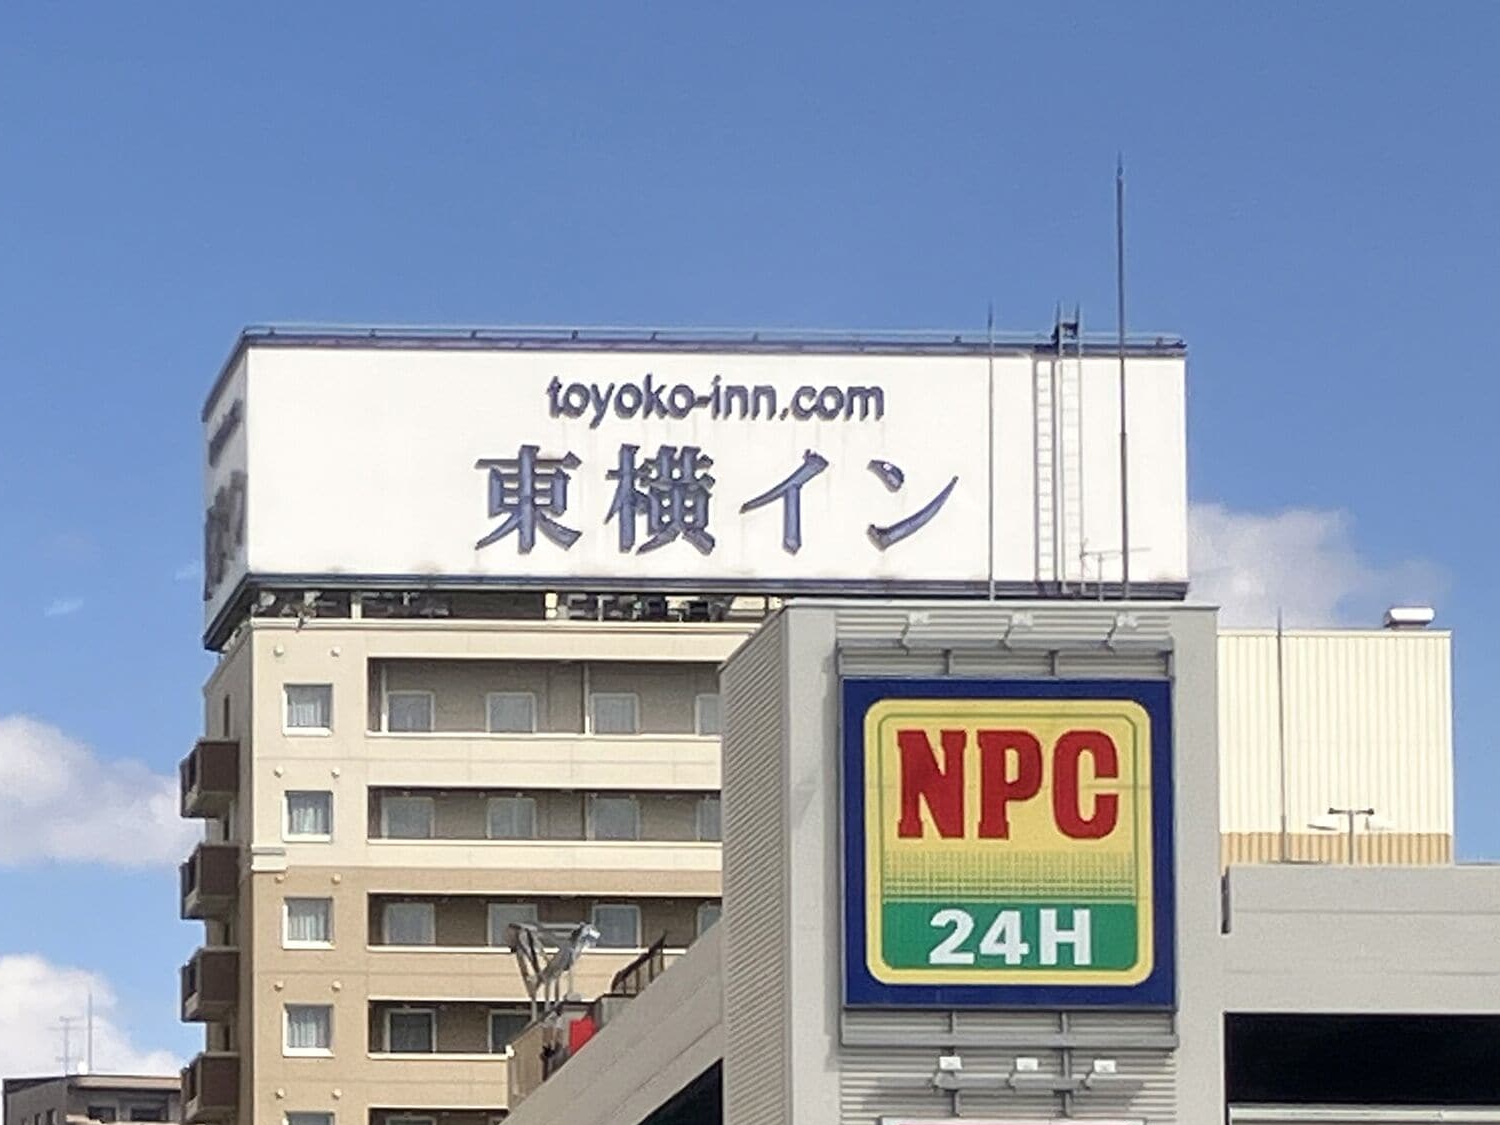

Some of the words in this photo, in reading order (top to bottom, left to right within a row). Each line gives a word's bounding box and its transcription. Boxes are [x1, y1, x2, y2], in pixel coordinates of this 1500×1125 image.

[546, 374, 886, 430] toyoko-inn.com
[474, 443, 959, 556] 東横イン
[896, 729, 1119, 840] NPC
[929, 908, 1092, 965] 24H
